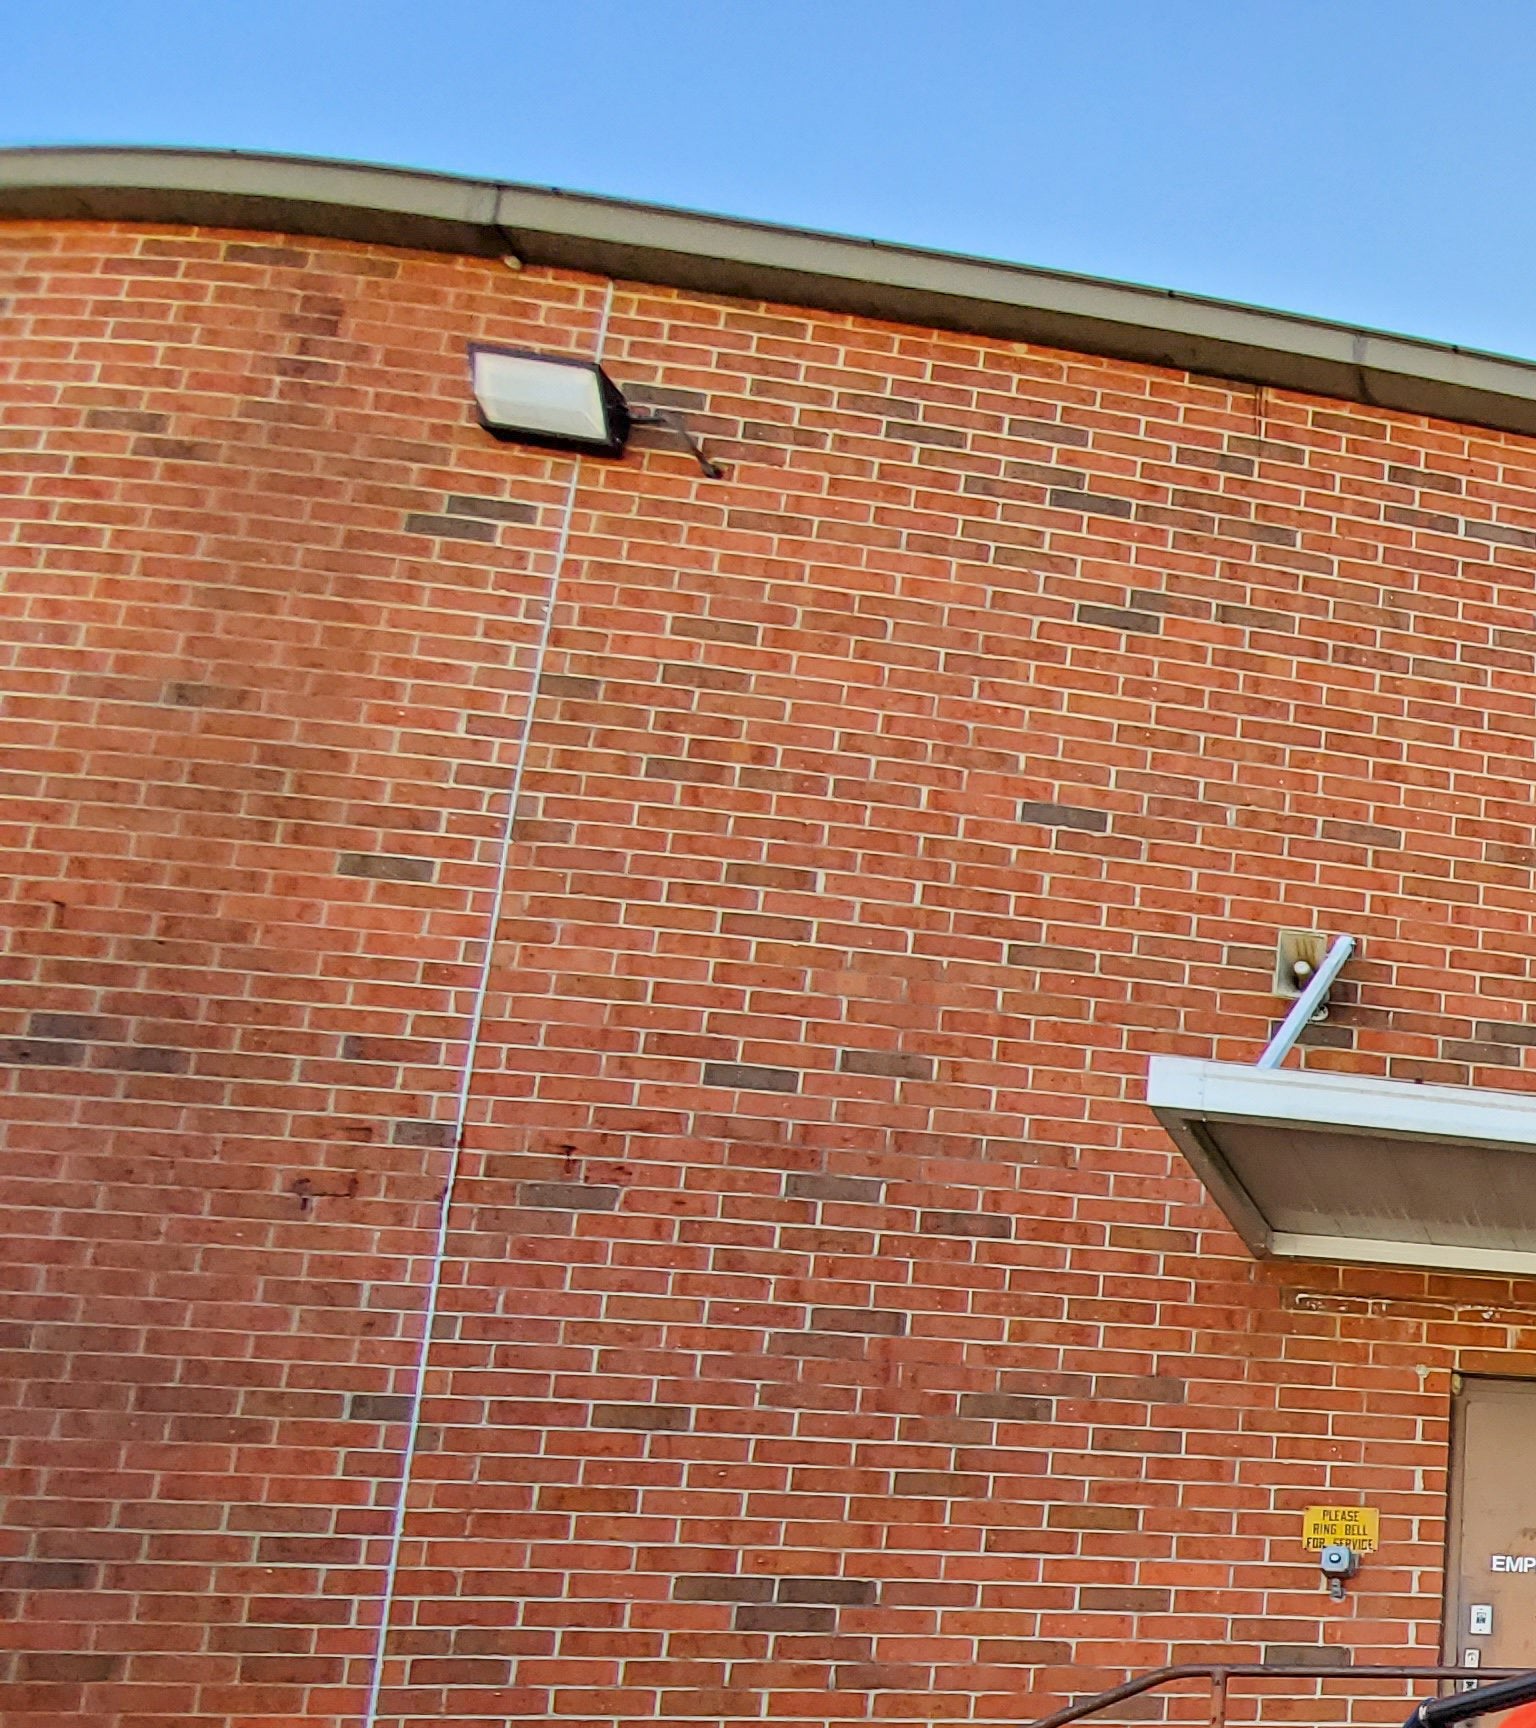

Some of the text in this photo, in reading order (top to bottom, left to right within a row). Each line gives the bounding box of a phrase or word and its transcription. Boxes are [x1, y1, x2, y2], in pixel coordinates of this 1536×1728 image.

[1322, 1509, 1360, 1522] PLEASE
[1312, 1523, 1368, 1536] RING BELL
[1306, 1537, 1326, 1549] FOR
